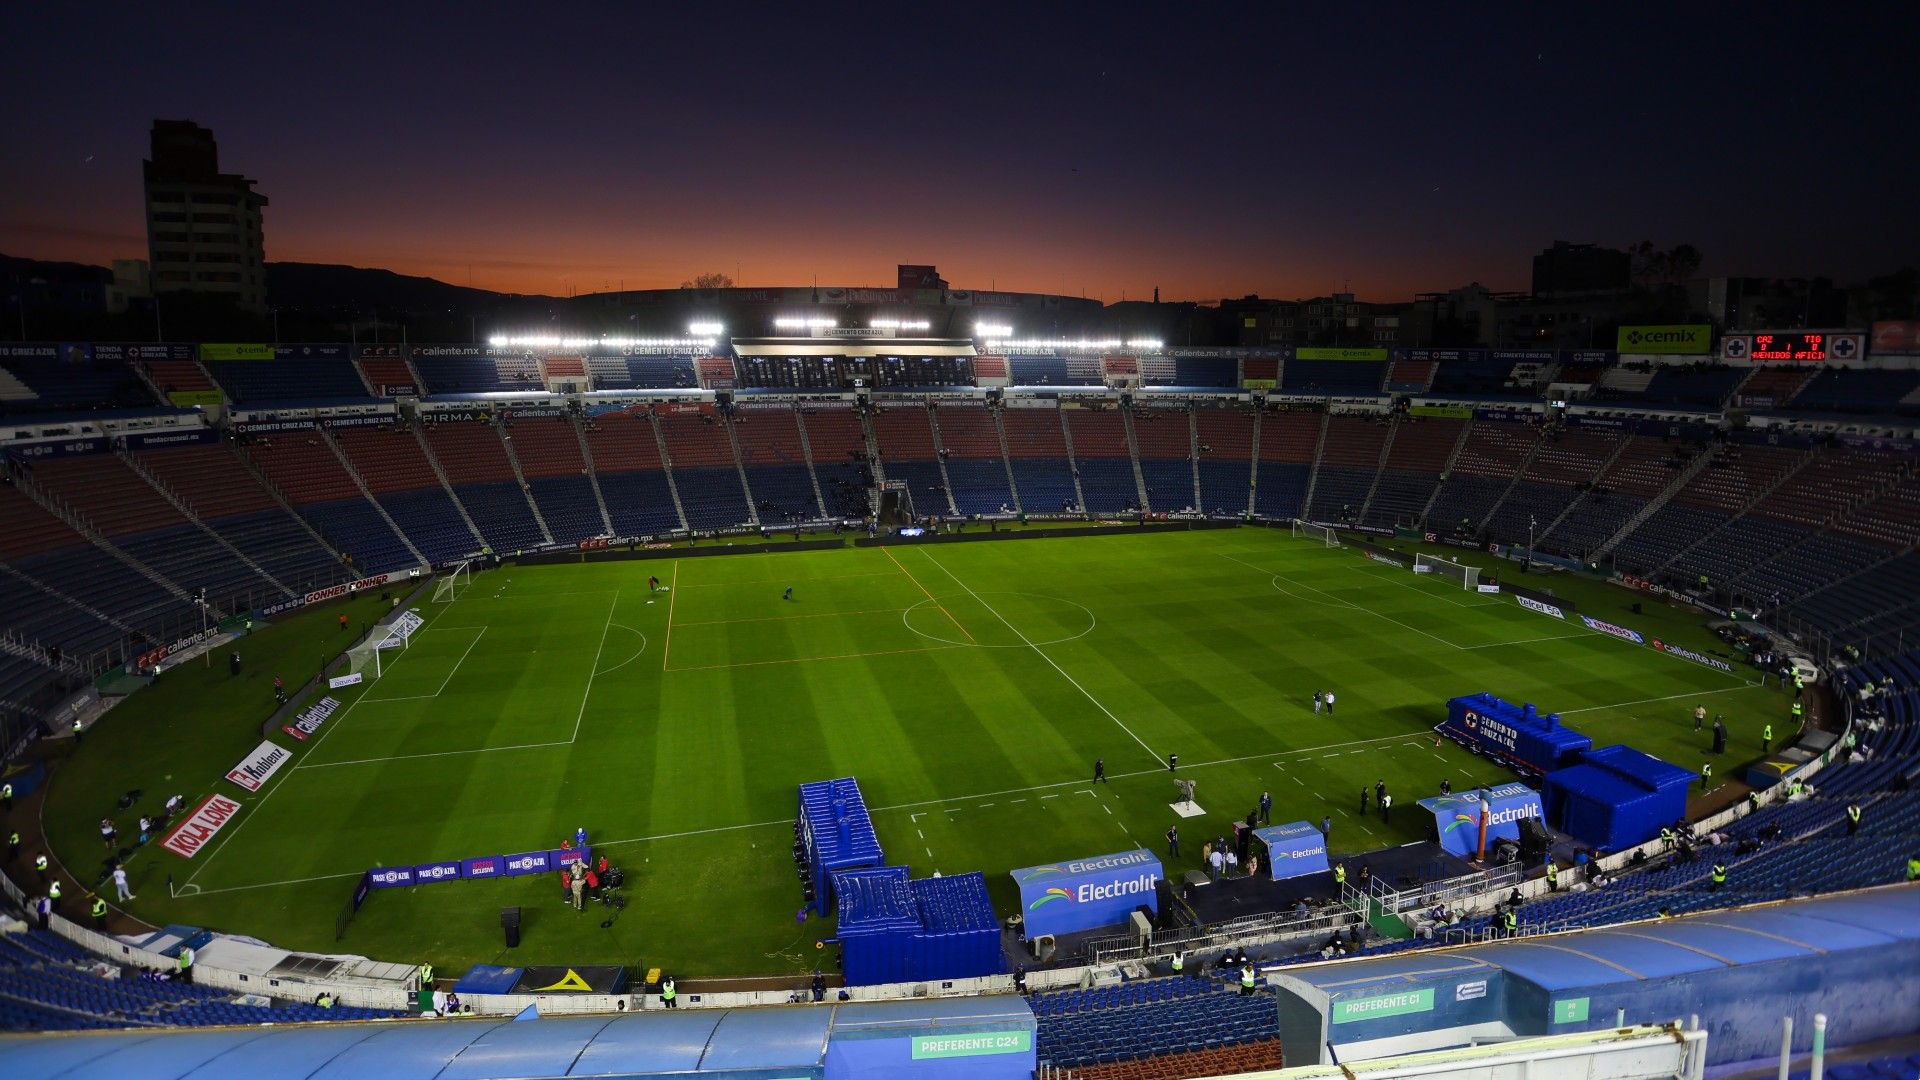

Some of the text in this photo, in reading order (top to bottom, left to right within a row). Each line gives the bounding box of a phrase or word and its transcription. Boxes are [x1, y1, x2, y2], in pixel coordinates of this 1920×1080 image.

[1645, 329, 1696, 343] cemix
[1757, 335, 1773, 343] CAZ
[422, 347, 479, 355] caliente.mx
[634, 346, 711, 355] CEMENTO CRUZ AZUL
[988, 347, 1021, 355] CEMENTO
[1022, 347, 1038, 355] CRUZ
[422, 413, 473, 422] PIRMA
[512, 409, 561, 418] caliente.mx
[247, 420, 315, 432] CEMENTO CRUZ AZUL
[332, 416, 395, 427] CEMENTO CRUZ AZUL
[306, 585, 346, 603] GONHER
[1519, 597, 1560, 615] telcel 5G
[1594, 620, 1631, 638] BIMBO
[168, 626, 218, 654] caliente.mx
[1664, 644, 1732, 671] caliente.mx
[1480, 715, 1517, 739] CEMENTO
[1479, 725, 1516, 752] CRUZ AZUL
[243, 748, 284, 780] Koblenz
[1486, 802, 1540, 826] lectrolit
[170, 798, 238, 854] KOLA LOKA
[1280, 825, 1312, 836] Electrolit
[1292, 846, 1323, 859] Electrolit
[509, 857, 545, 870] PASE AZUL
[1068, 853, 1150, 873] Electrolit
[373, 871, 410, 882] PASE AZUL
[419, 866, 456, 878] PASE AZUL
[472, 867, 494, 875] EXCLUSIVO
[1078, 873, 1159, 903] Electrolit
[1346, 994, 1419, 1014] PREFERENTE C1
[921, 1036, 1019, 1053] PREFERENTE C24
